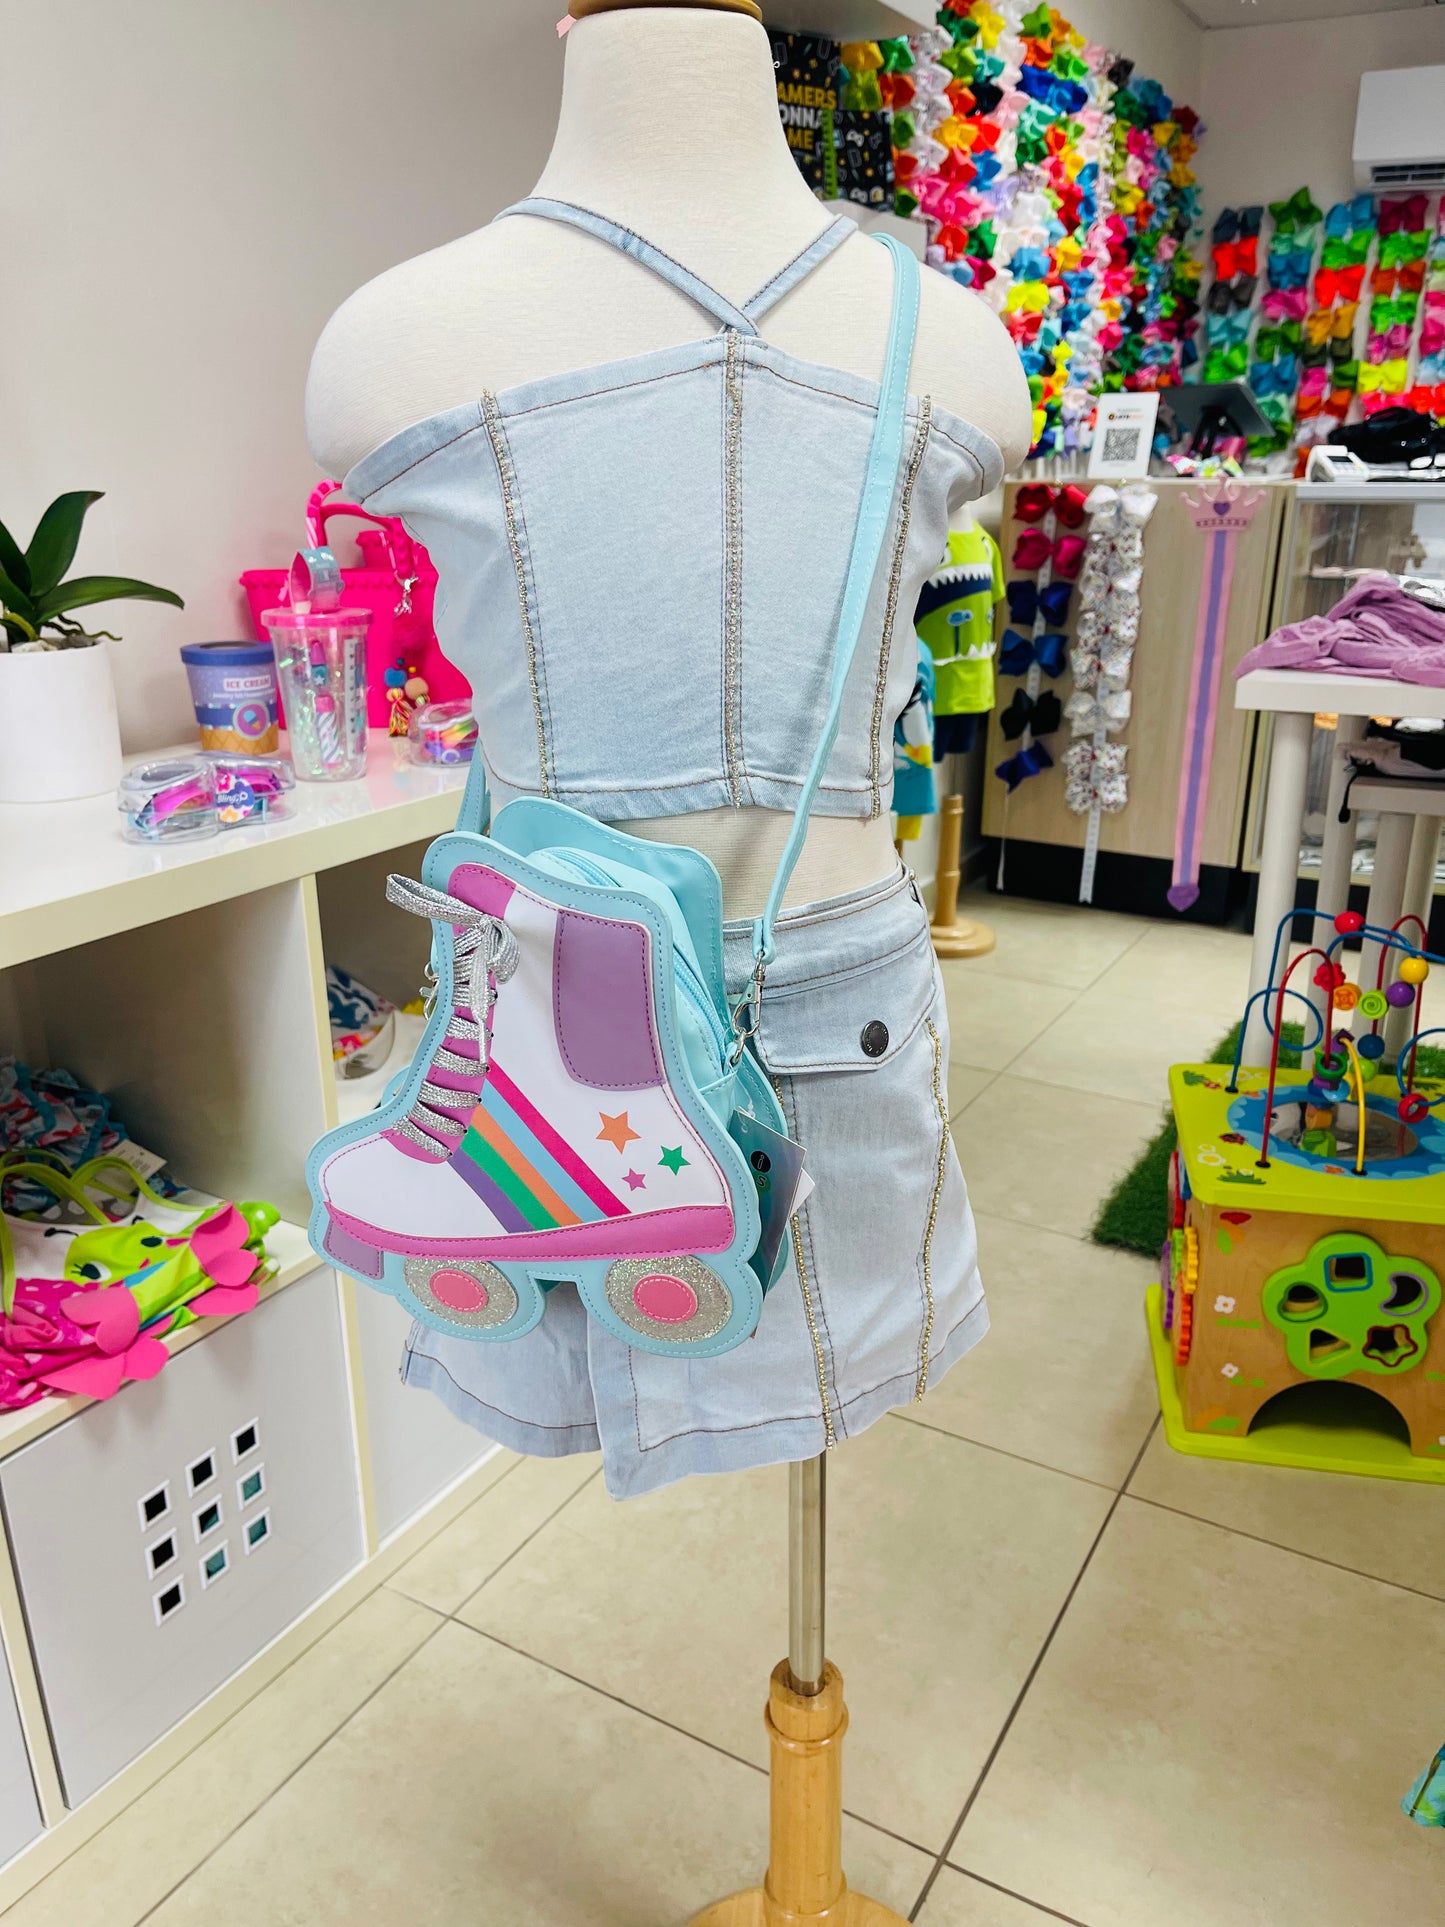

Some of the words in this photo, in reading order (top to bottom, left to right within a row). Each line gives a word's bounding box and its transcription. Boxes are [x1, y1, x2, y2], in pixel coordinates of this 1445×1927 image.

[777, 81, 837, 110] AMERS
[778, 104, 822, 129] ONN
[787, 128, 814, 150] ME
[226, 680, 240, 689] ICE
[243, 676, 270, 689] CREAM
